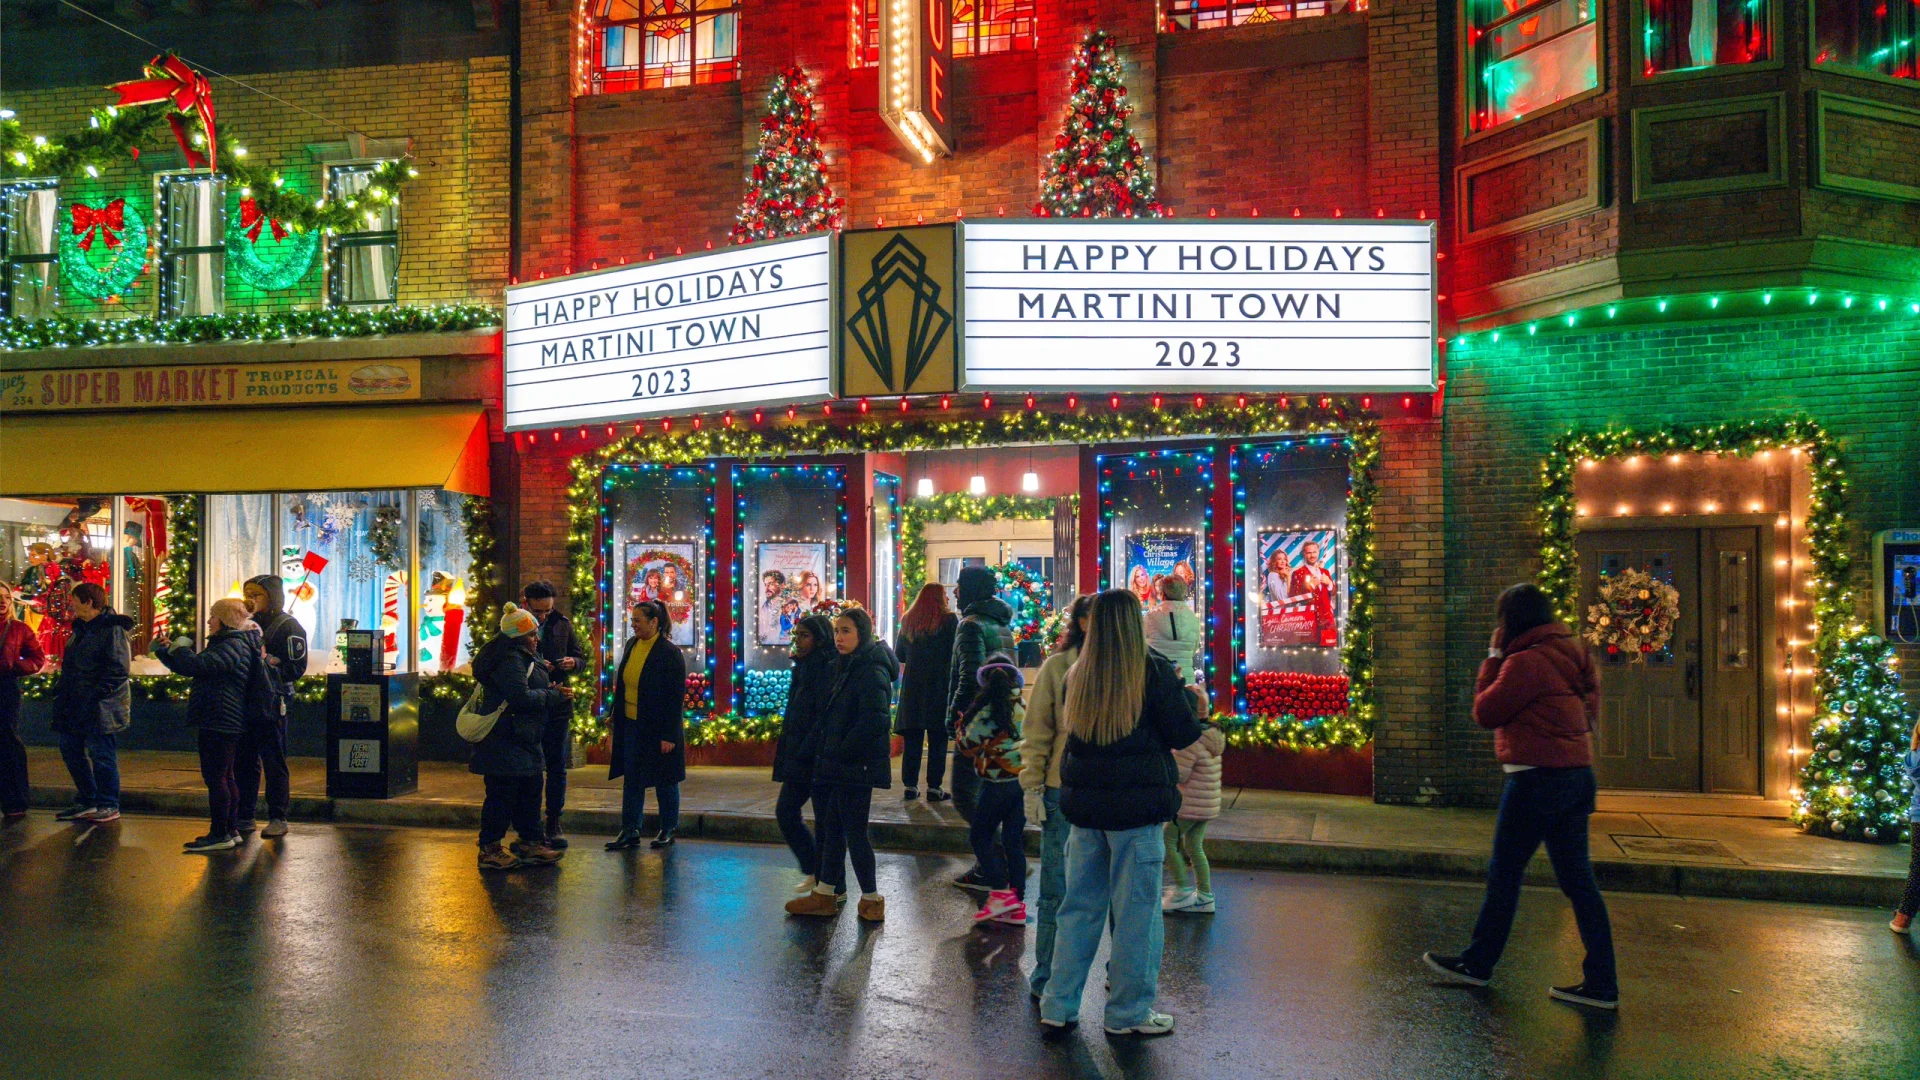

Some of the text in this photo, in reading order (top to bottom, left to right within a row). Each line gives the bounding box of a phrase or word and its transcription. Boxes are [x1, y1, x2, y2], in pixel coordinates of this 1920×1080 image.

[1022, 244, 1386, 272] HAPPY HOLIDAYS
[533, 264, 783, 326] HAPPY HOLIDAYS
[1018, 293, 1341, 319] MARTINI TOWN
[541, 314, 761, 366] MARTINI TOWN
[1155, 341, 1241, 367] 2023
[246, 368, 338, 383] TROPICAL
[632, 368, 691, 397] 2023
[42, 368, 239, 405] SUPER MARKET
[246, 383, 339, 397] PRODUCTS
[13, 396, 34, 406] 234
[1147, 558, 1175, 569] Village
[350, 751, 370, 760] YORK
[351, 743, 369, 752] NEW
[349, 758, 369, 768] POST
